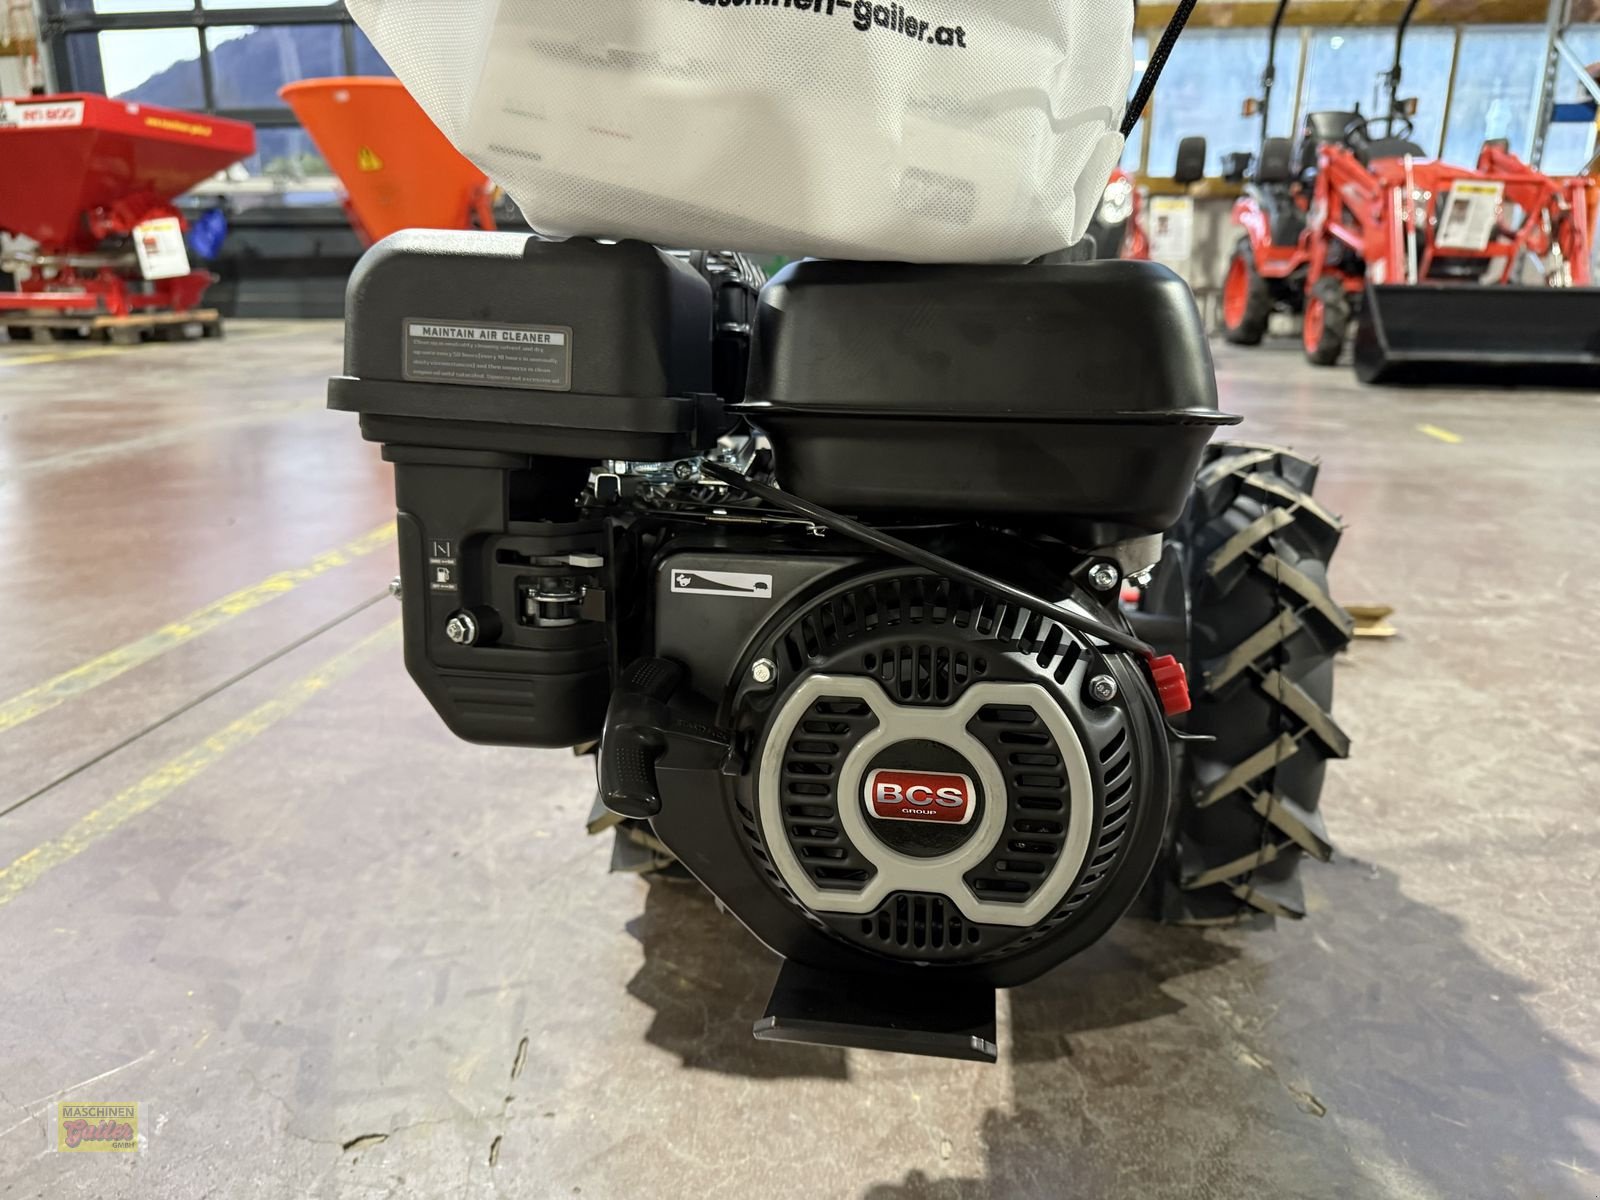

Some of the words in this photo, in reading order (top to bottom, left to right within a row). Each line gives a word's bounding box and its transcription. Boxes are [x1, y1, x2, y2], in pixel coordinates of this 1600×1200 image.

[422, 327, 475, 338] MAINTAIN
[479, 329, 498, 340] AIR
[502, 331, 551, 343] CLEANER
[877, 783, 963, 807] BCS
